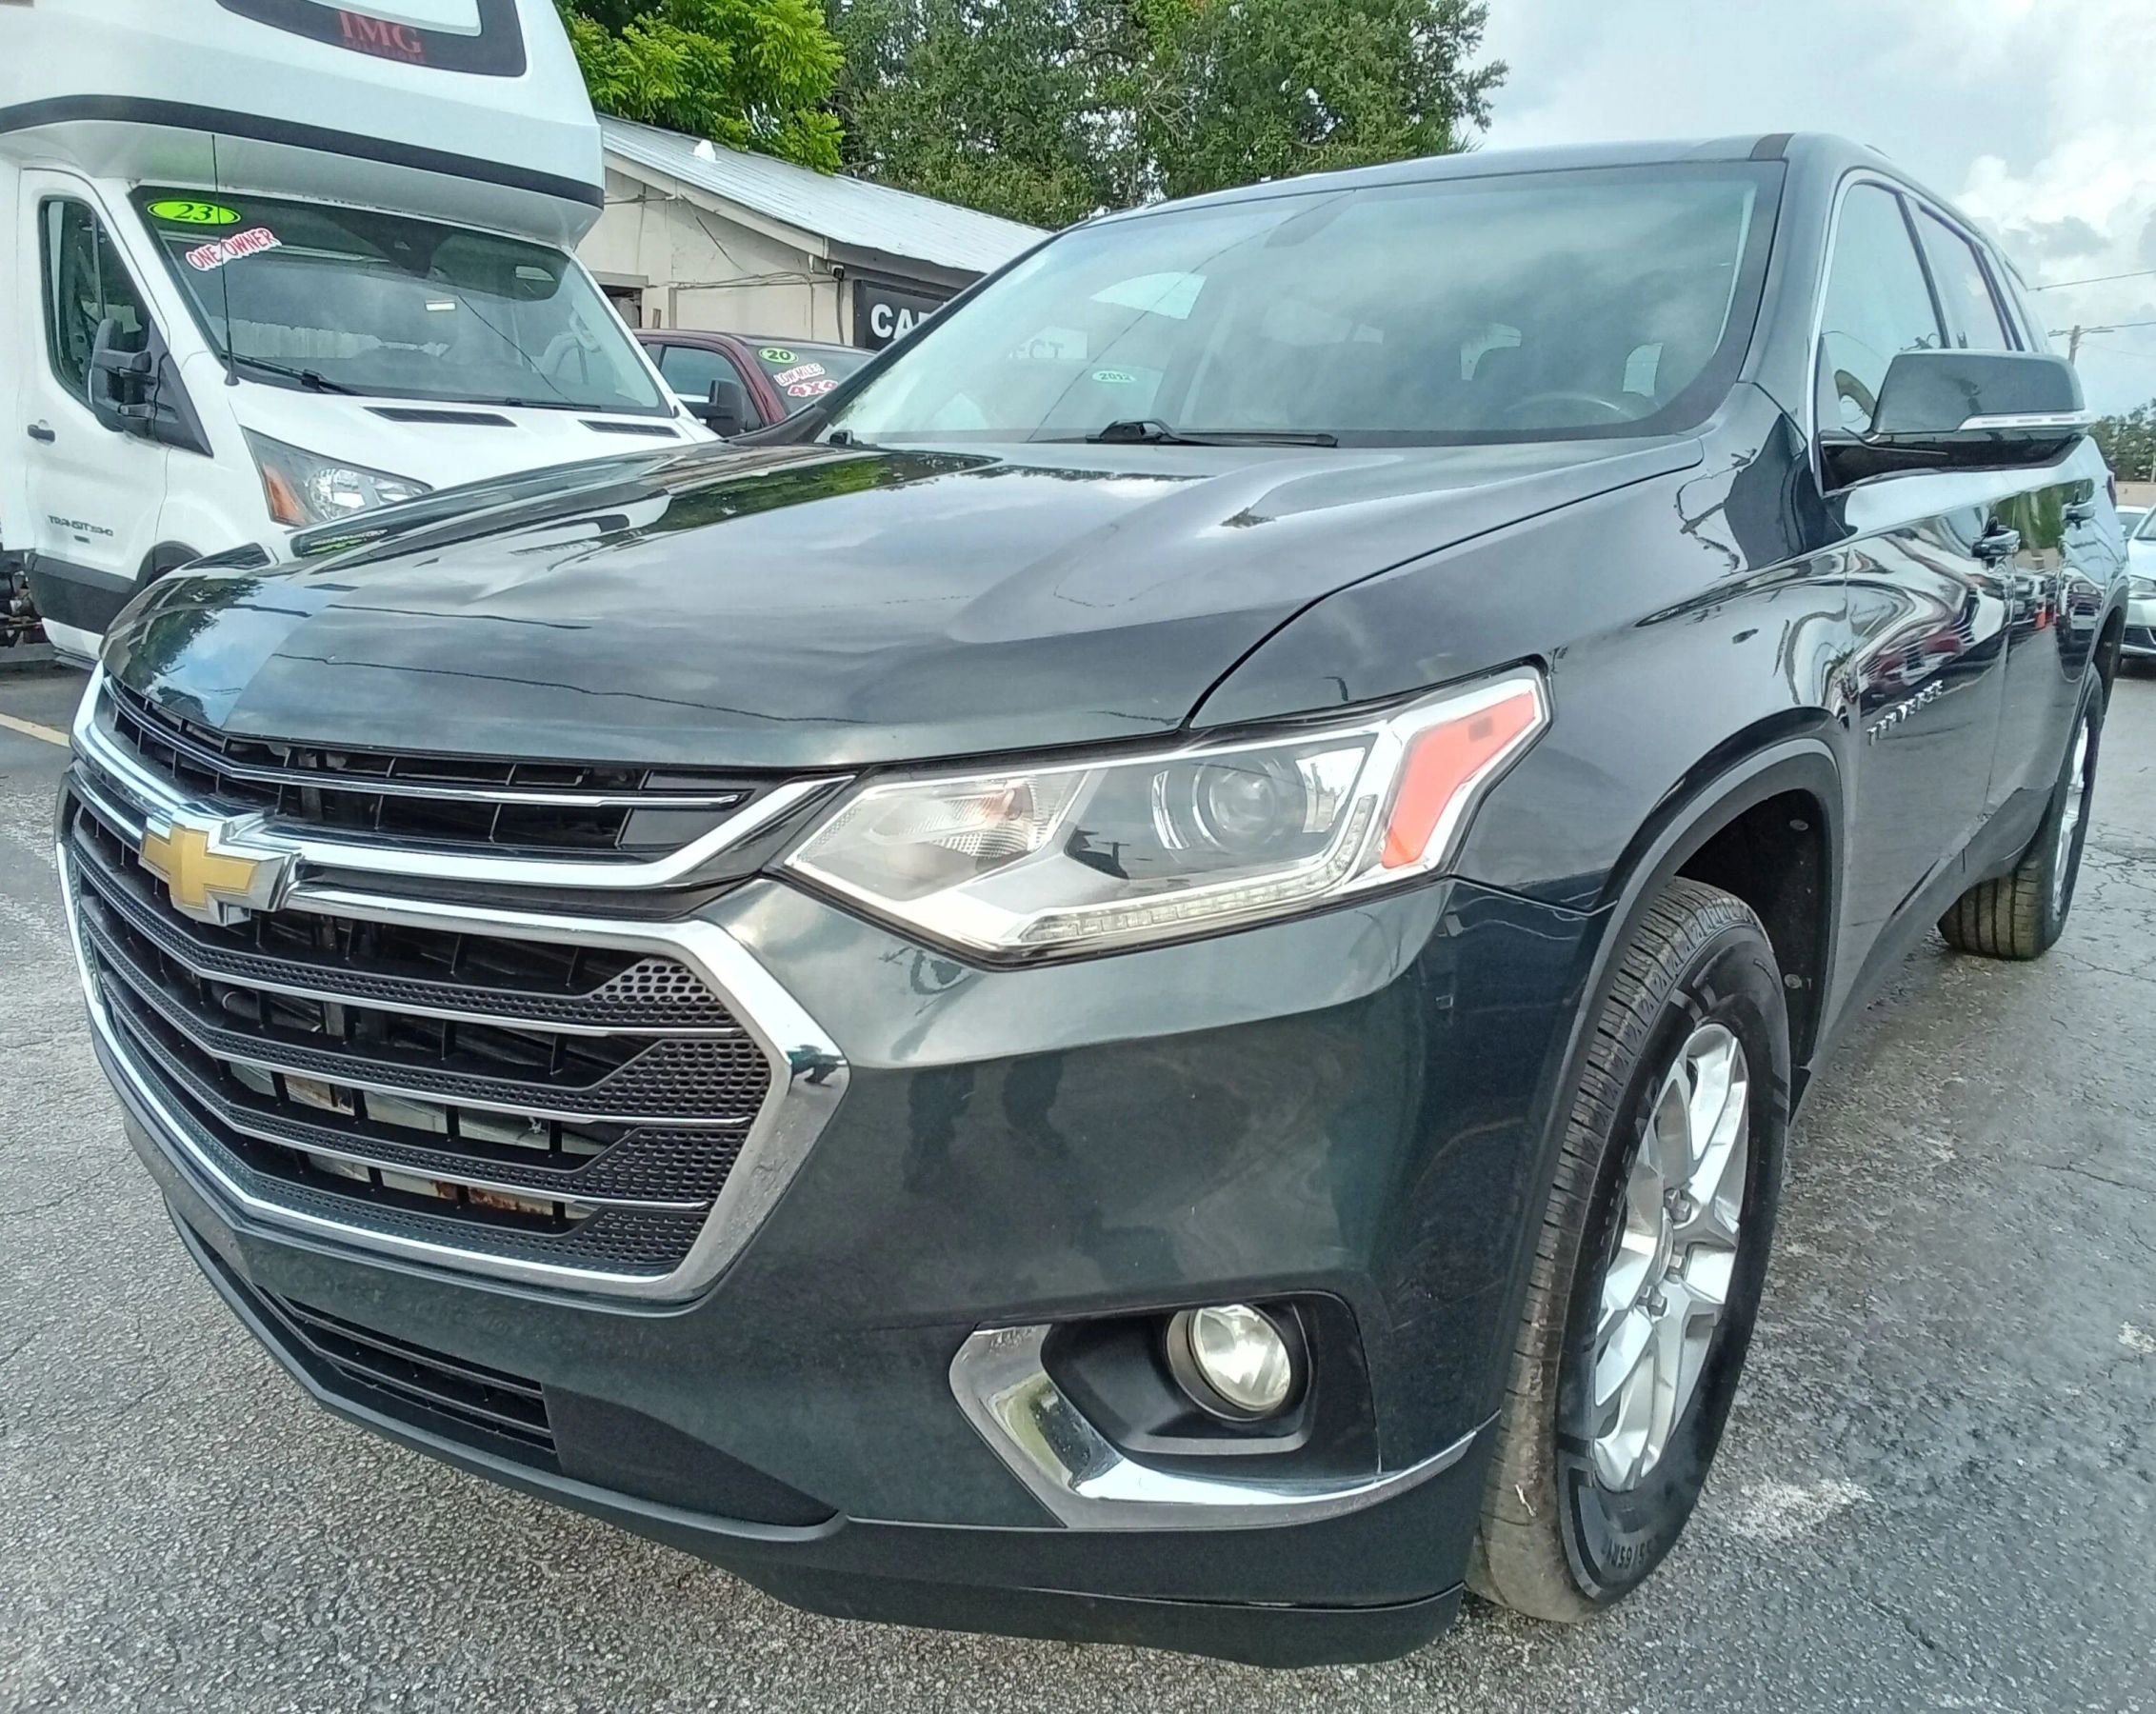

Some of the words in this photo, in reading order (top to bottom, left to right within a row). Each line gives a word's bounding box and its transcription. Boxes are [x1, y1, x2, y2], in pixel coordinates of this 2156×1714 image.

[339, 10, 422, 53] IMG
[173, 203, 214, 221] 23
[190, 246, 218, 269] ONE
[222, 229, 275, 256] OWNER
[766, 349, 791, 361] 20
